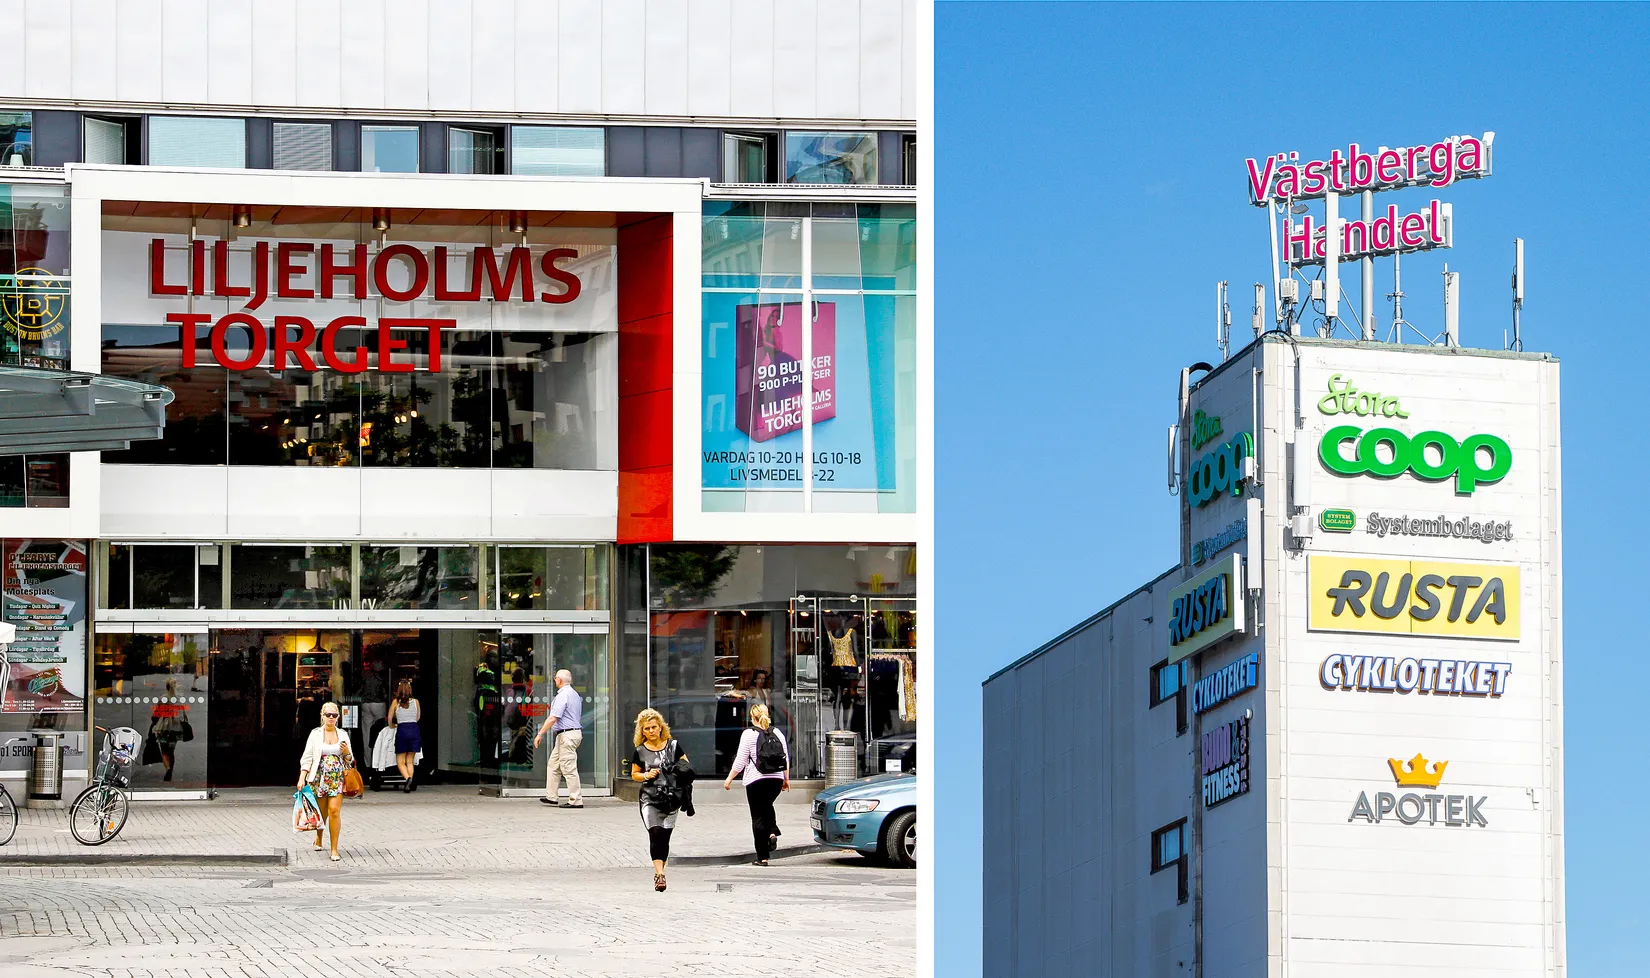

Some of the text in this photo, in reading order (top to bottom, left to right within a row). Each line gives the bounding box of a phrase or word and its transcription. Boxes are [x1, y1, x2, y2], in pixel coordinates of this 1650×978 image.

[1245, 136, 1484, 202] Västberga
[1282, 199, 1444, 262] Handel
[151, 238, 581, 311] LILJEHOLMS
[28, 328, 52, 340] BRUINS
[51, 321, 65, 334] BAR
[166, 313, 457, 373] TORGET
[757, 355, 831, 379] 90 BUTKER
[759, 379, 781, 392] 900
[1318, 373, 1410, 419] Stora
[764, 410, 804, 432] TORG
[1191, 408, 1224, 450] Stora
[703, 451, 861, 465] VARDAG 10-20 HLG 10-18
[730, 469, 802, 481] LIVSMEDEL
[1188, 432, 1254, 508] coop
[1318, 425, 1513, 495] coop
[1367, 512, 1513, 542] Systembolaget
[23, 577, 40, 586] nya
[1326, 569, 1506, 625] RUSTA
[1169, 573, 1228, 646] RUSTA
[1193, 653, 1257, 715] CYKLOTEKET
[1320, 653, 1512, 698] CYKLOTEKET
[1202, 723, 1231, 775] BUDO
[1202, 762, 1240, 808] FITNESS
[1348, 790, 1489, 826] APOTEK
